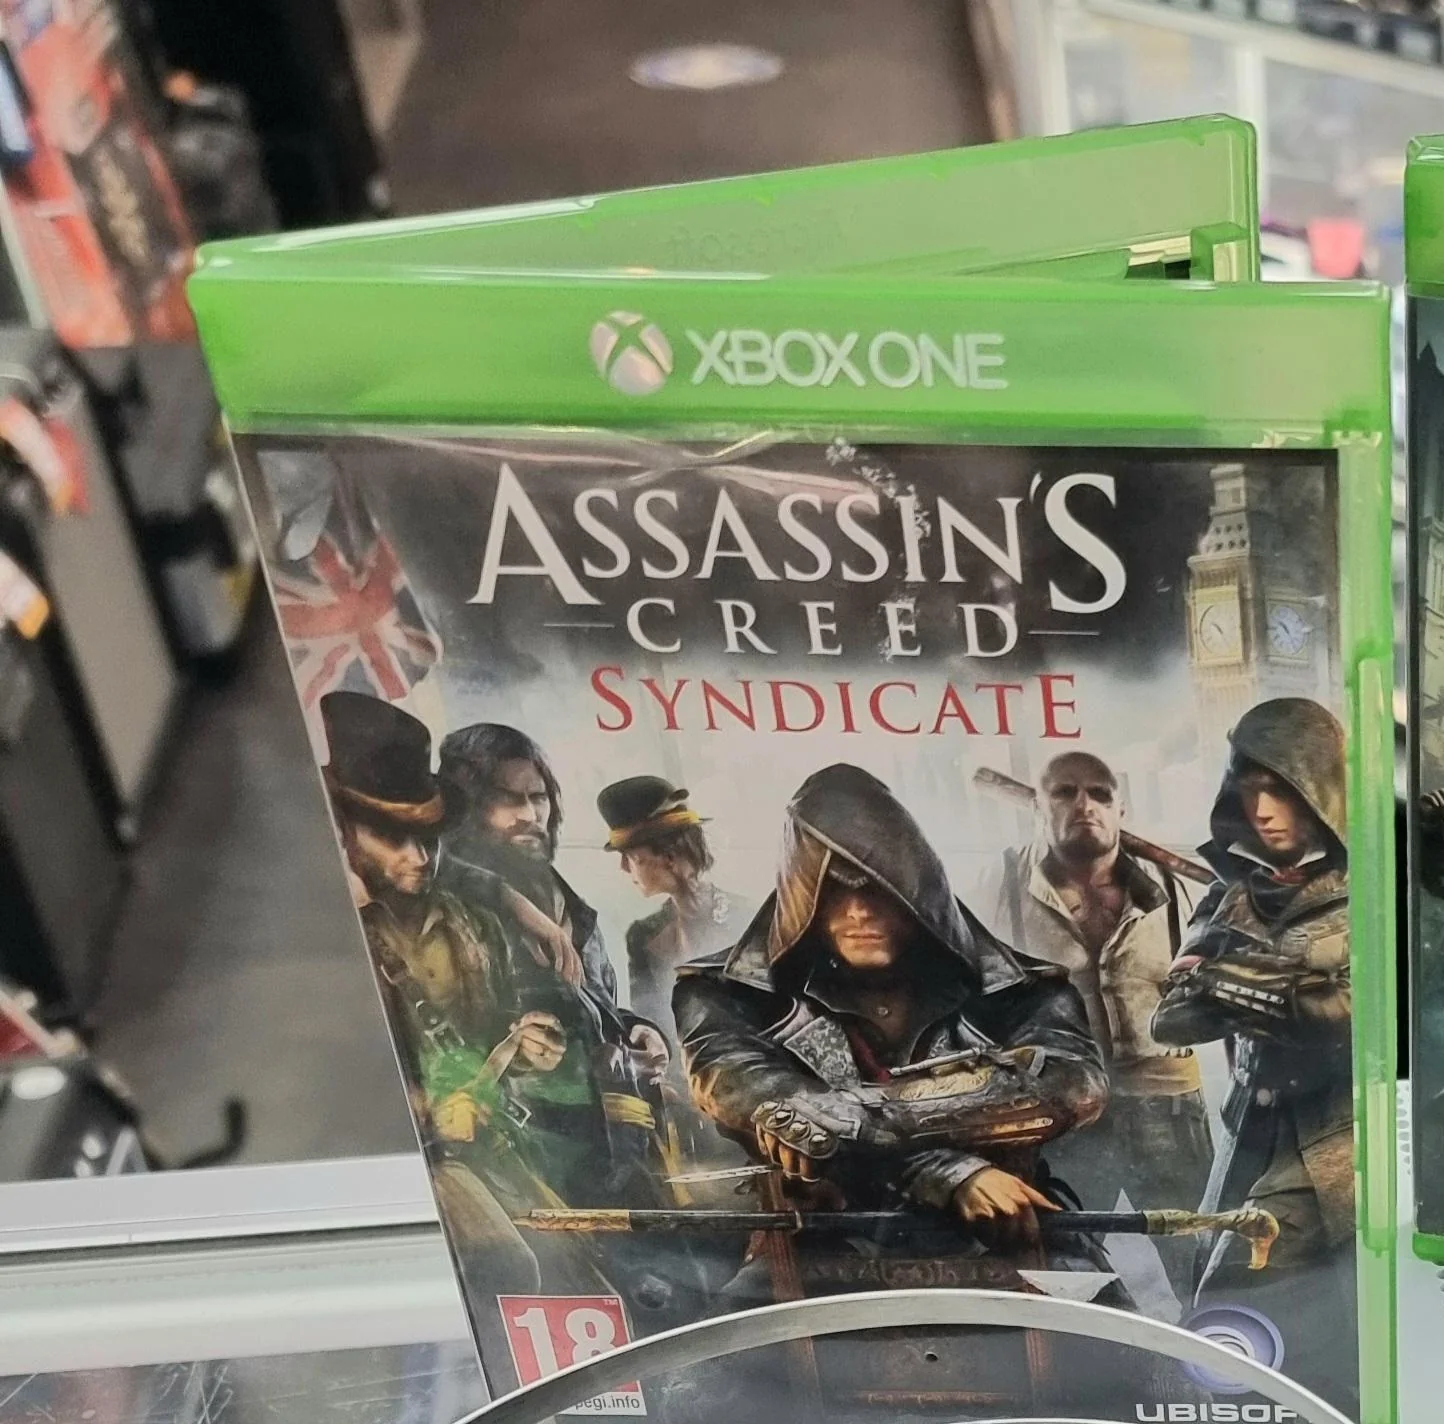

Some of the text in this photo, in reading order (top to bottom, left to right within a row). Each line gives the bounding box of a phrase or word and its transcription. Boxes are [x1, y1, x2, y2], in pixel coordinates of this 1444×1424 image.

[686, 329, 1009, 389] XBOX ONE
[466, 462, 1127, 614] ASSASSIN'S
[626, 597, 1019, 658] CREED
[589, 665, 1082, 739] SYNDICATE
[513, 1307, 616, 1379] 18
[575, 1395, 641, 1412] pegi.info
[1135, 1403, 1299, 1424] UBISOF
